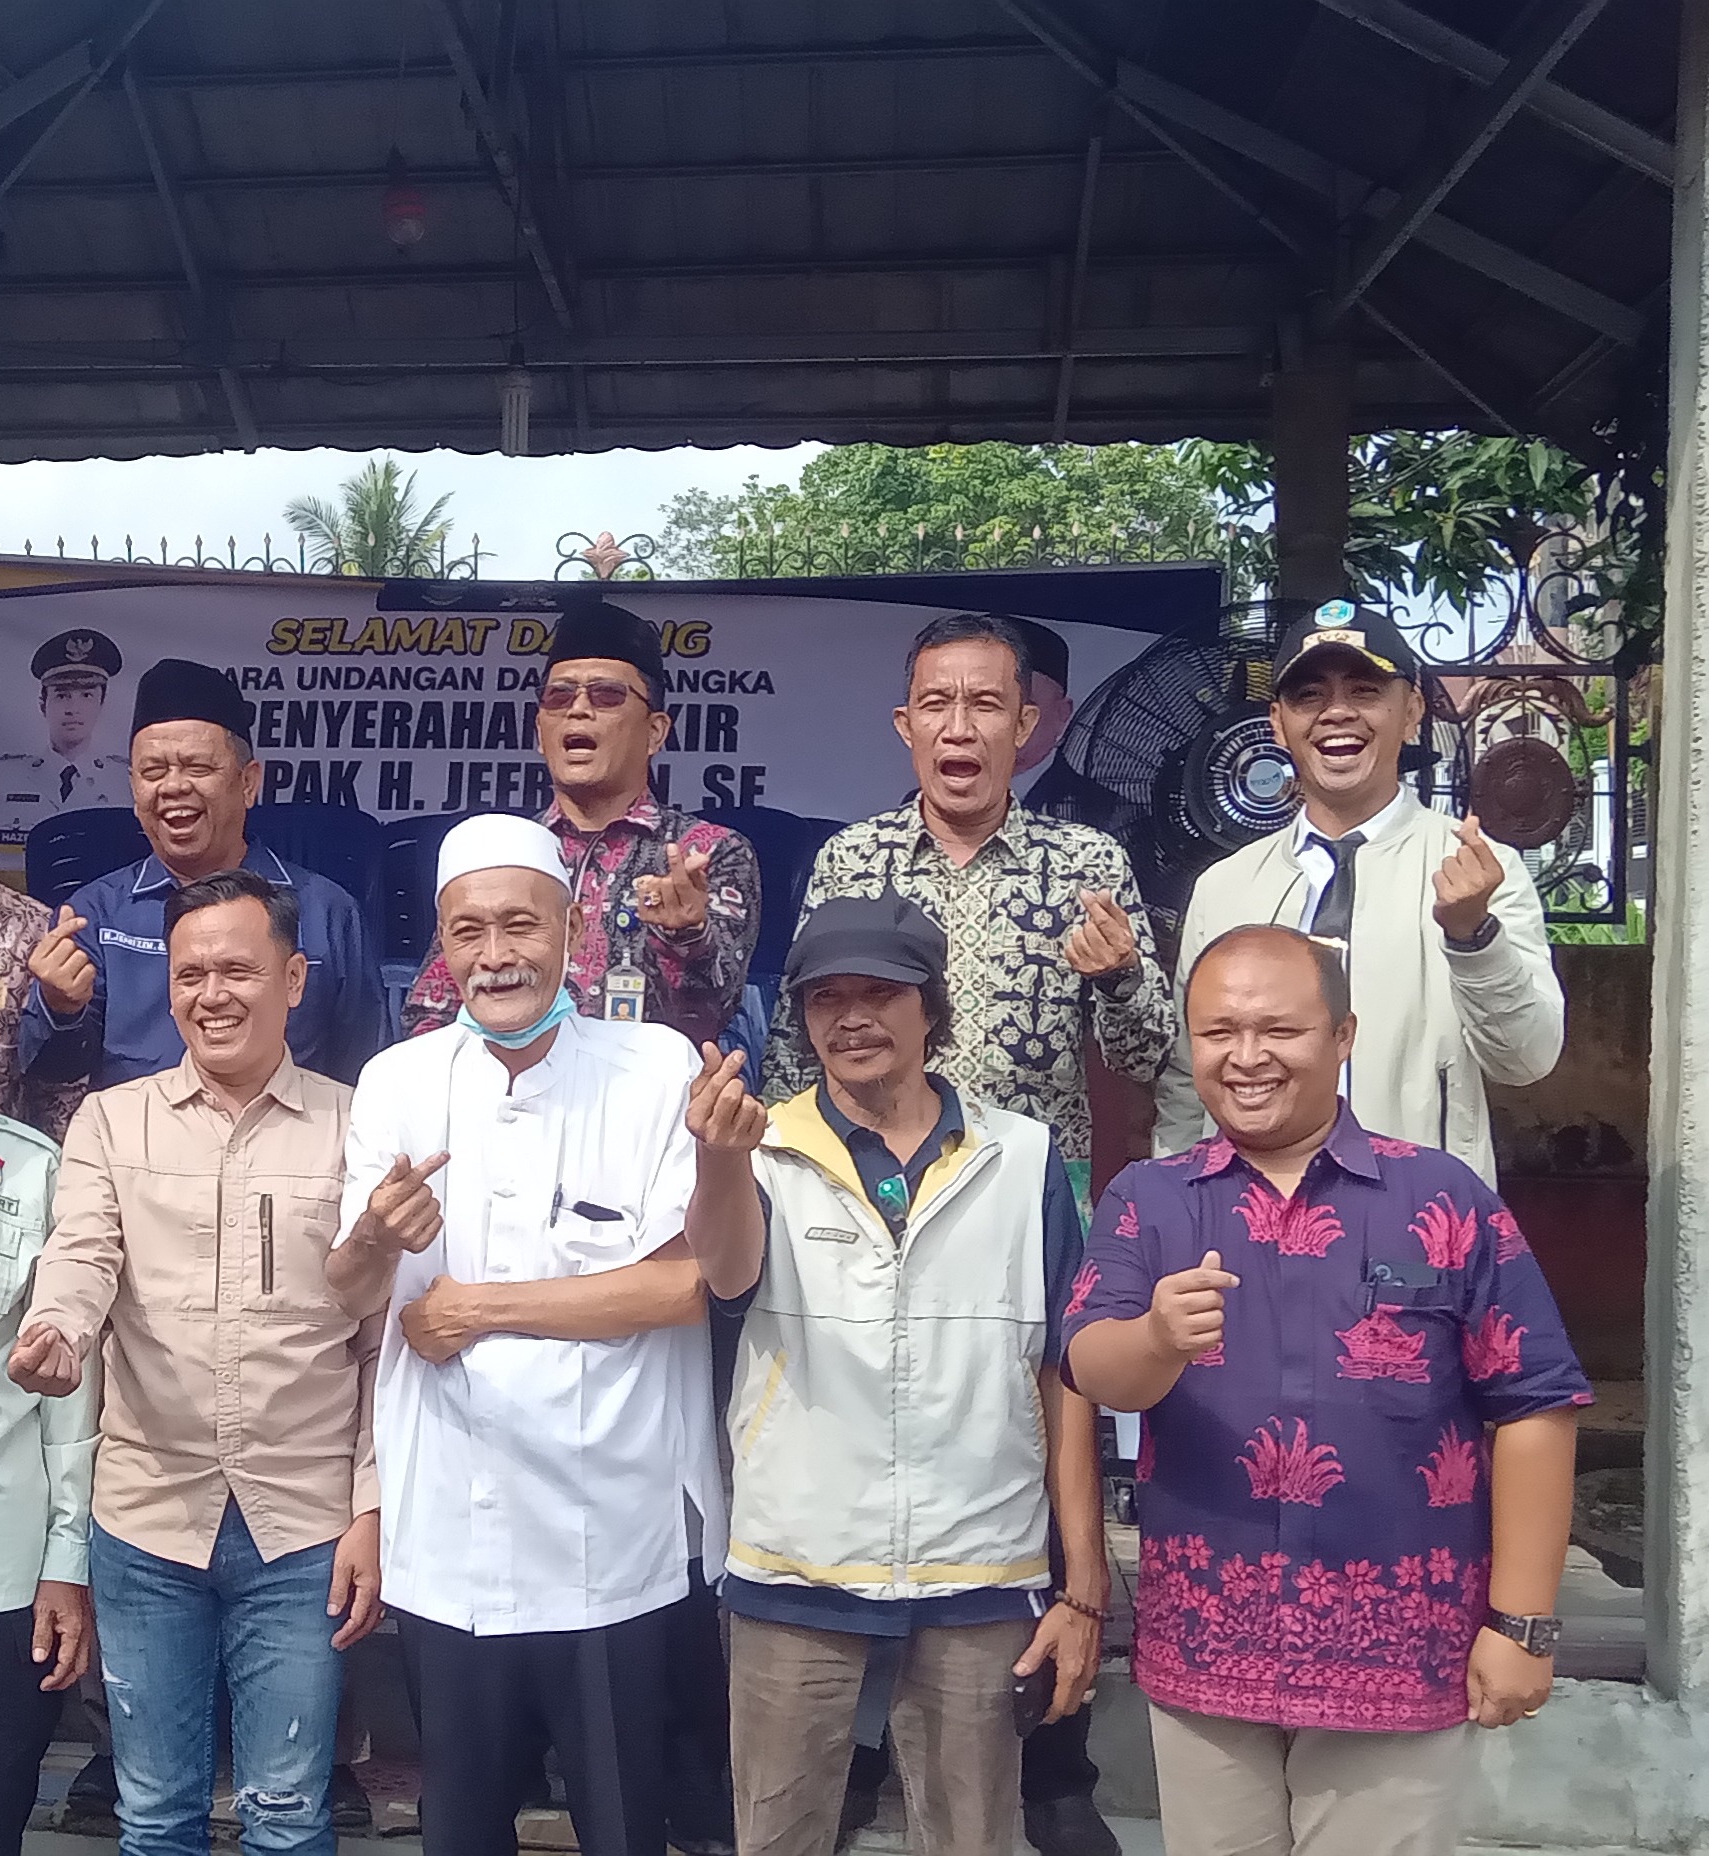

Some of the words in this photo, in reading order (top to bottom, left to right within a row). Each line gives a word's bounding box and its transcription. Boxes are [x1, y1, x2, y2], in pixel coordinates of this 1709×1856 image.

[266, 616, 500, 656] SELAMAT
[212, 666, 285, 692] ARA
[296, 666, 485, 692] UNDANGAN
[664, 669, 775, 694] ANGKA
[249, 700, 539, 750] ENYERAHA
[263, 760, 362, 806] PAK
[378, 760, 426, 812] H.
